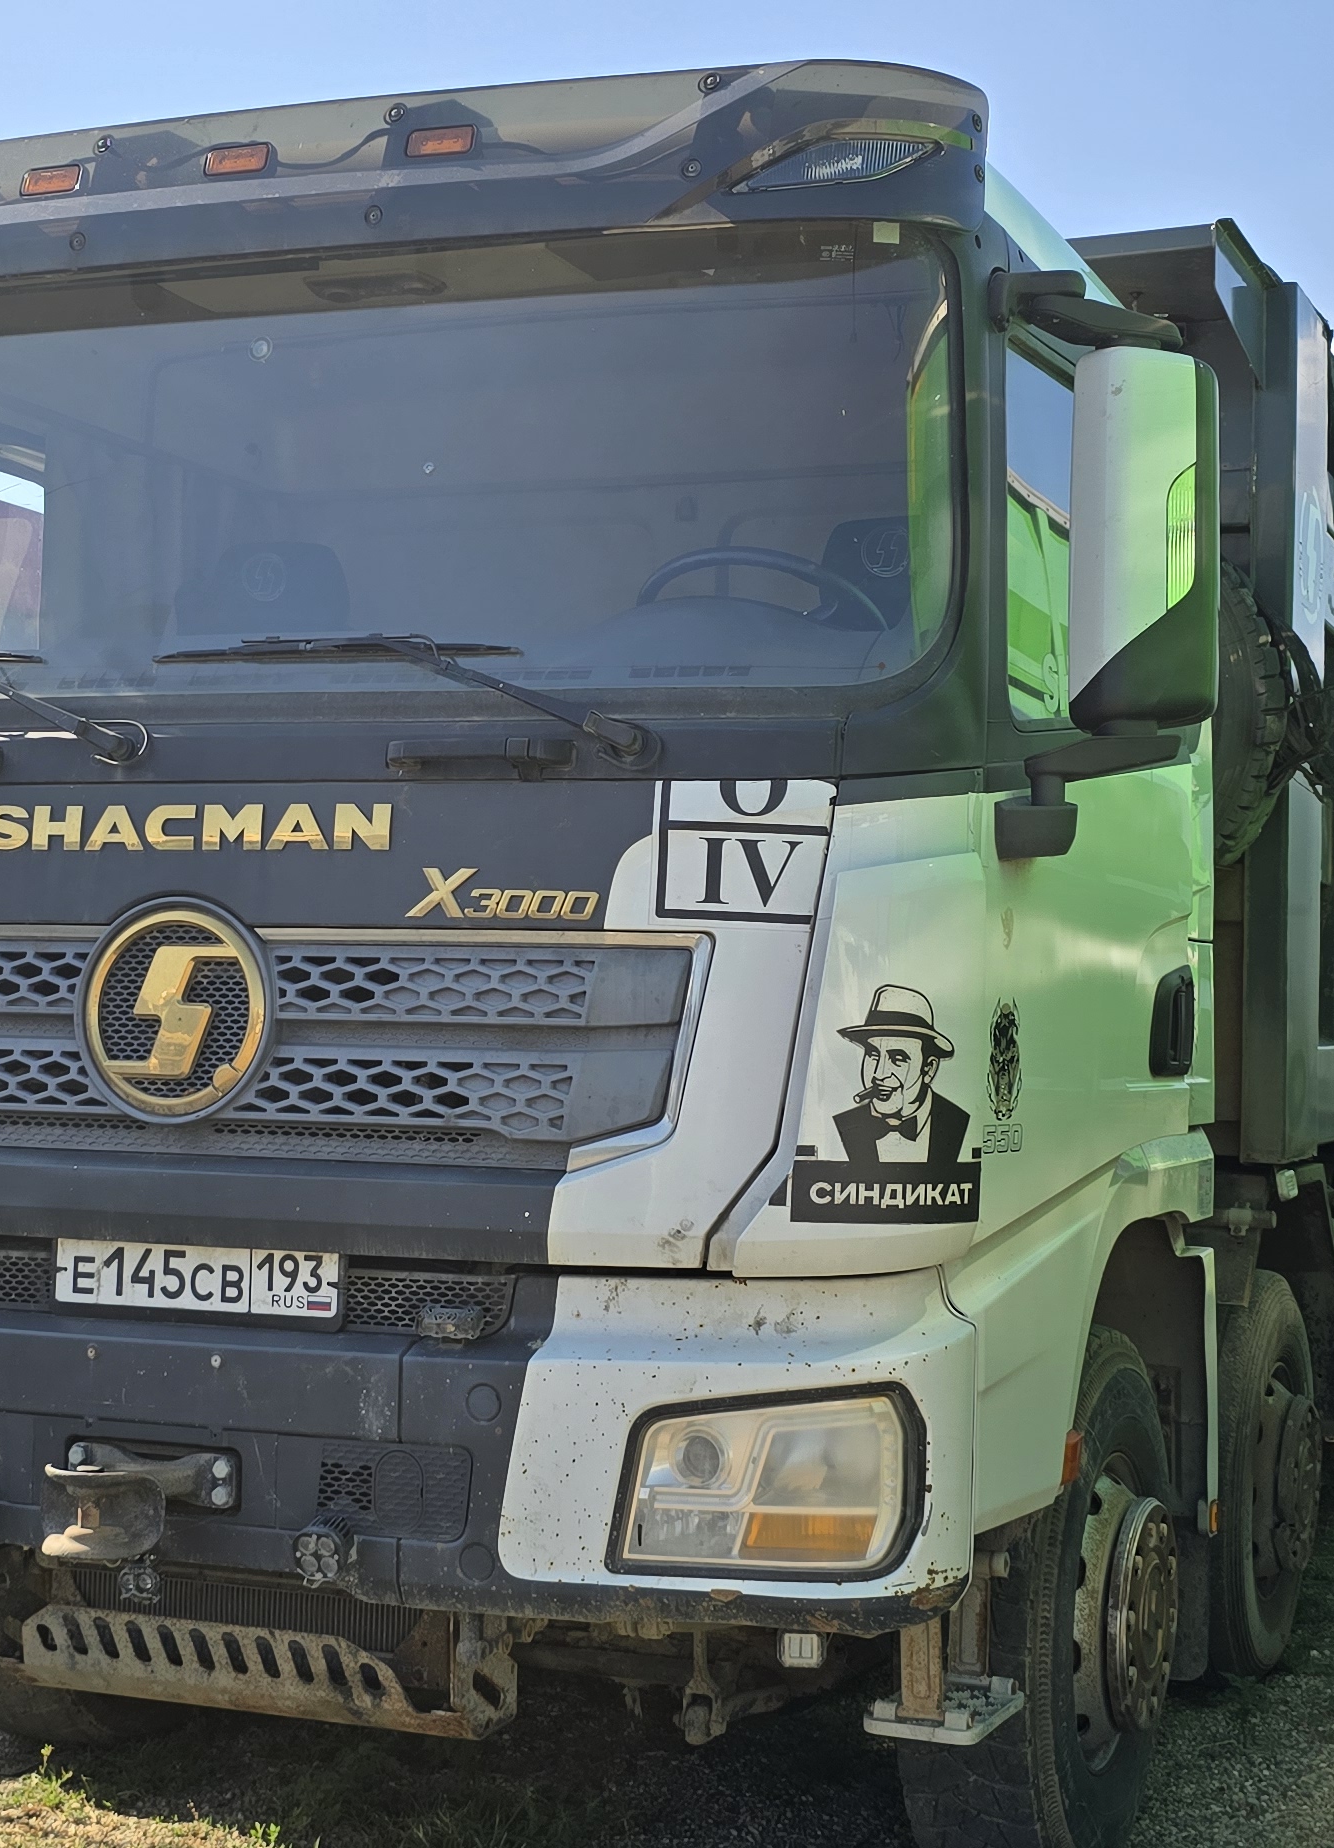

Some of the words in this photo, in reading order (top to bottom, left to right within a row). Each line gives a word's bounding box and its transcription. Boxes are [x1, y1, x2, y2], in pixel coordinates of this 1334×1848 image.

[695, 836, 803, 908] IV
[405, 867, 599, 921] X3000
[983, 1123, 1023, 1154] 550
[809, 1181, 973, 1209] СИНДИКАТ
[73, 1247, 244, 1303] Е145СВ
[256, 1252, 323, 1293] 193
[271, 1295, 305, 1309] RUS
